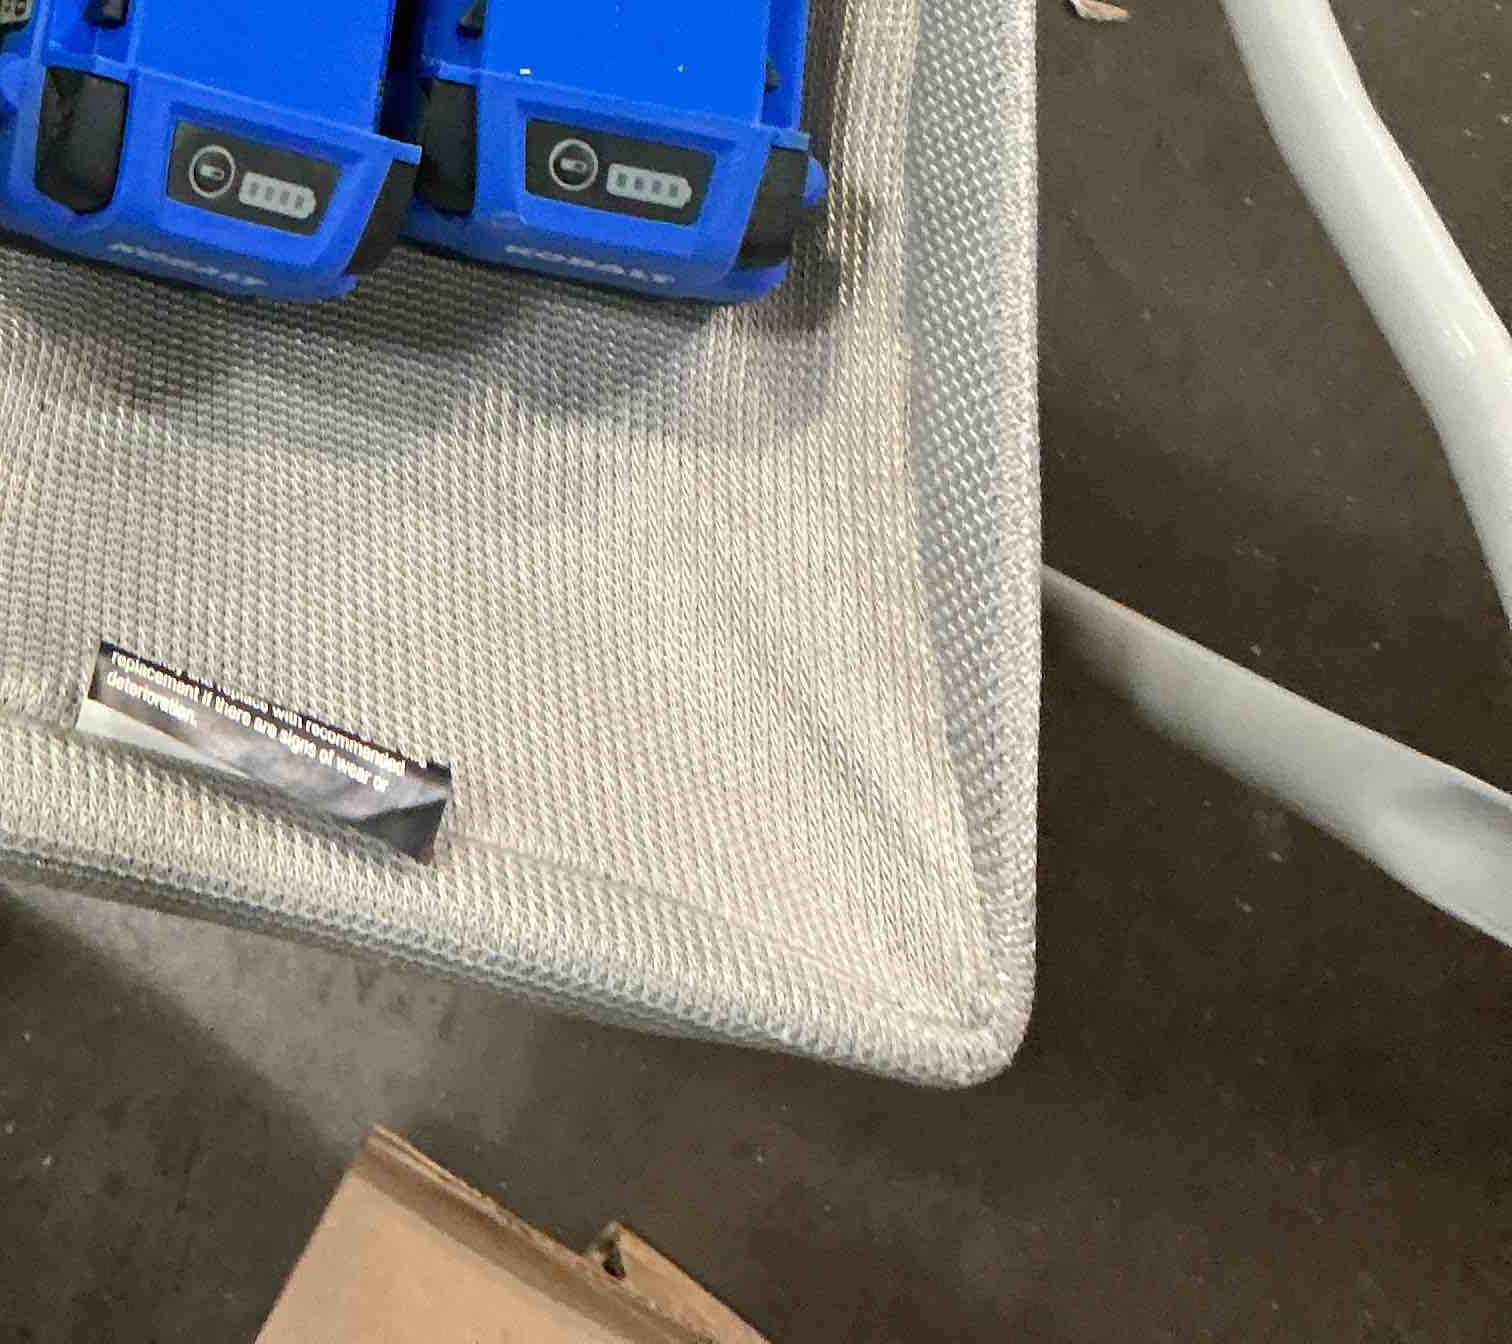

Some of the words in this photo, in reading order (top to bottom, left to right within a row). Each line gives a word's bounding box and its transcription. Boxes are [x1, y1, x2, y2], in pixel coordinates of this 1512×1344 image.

[106, 670, 198, 729] deterioration.
[111, 650, 200, 704] replacement
[201, 689, 214, 707] if
[214, 695, 252, 728] there
[253, 717, 278, 740] are
[279, 728, 318, 760] signs
[319, 747, 336, 767] of
[336, 756, 373, 785] wear
[305, 719, 407, 777] recommended
